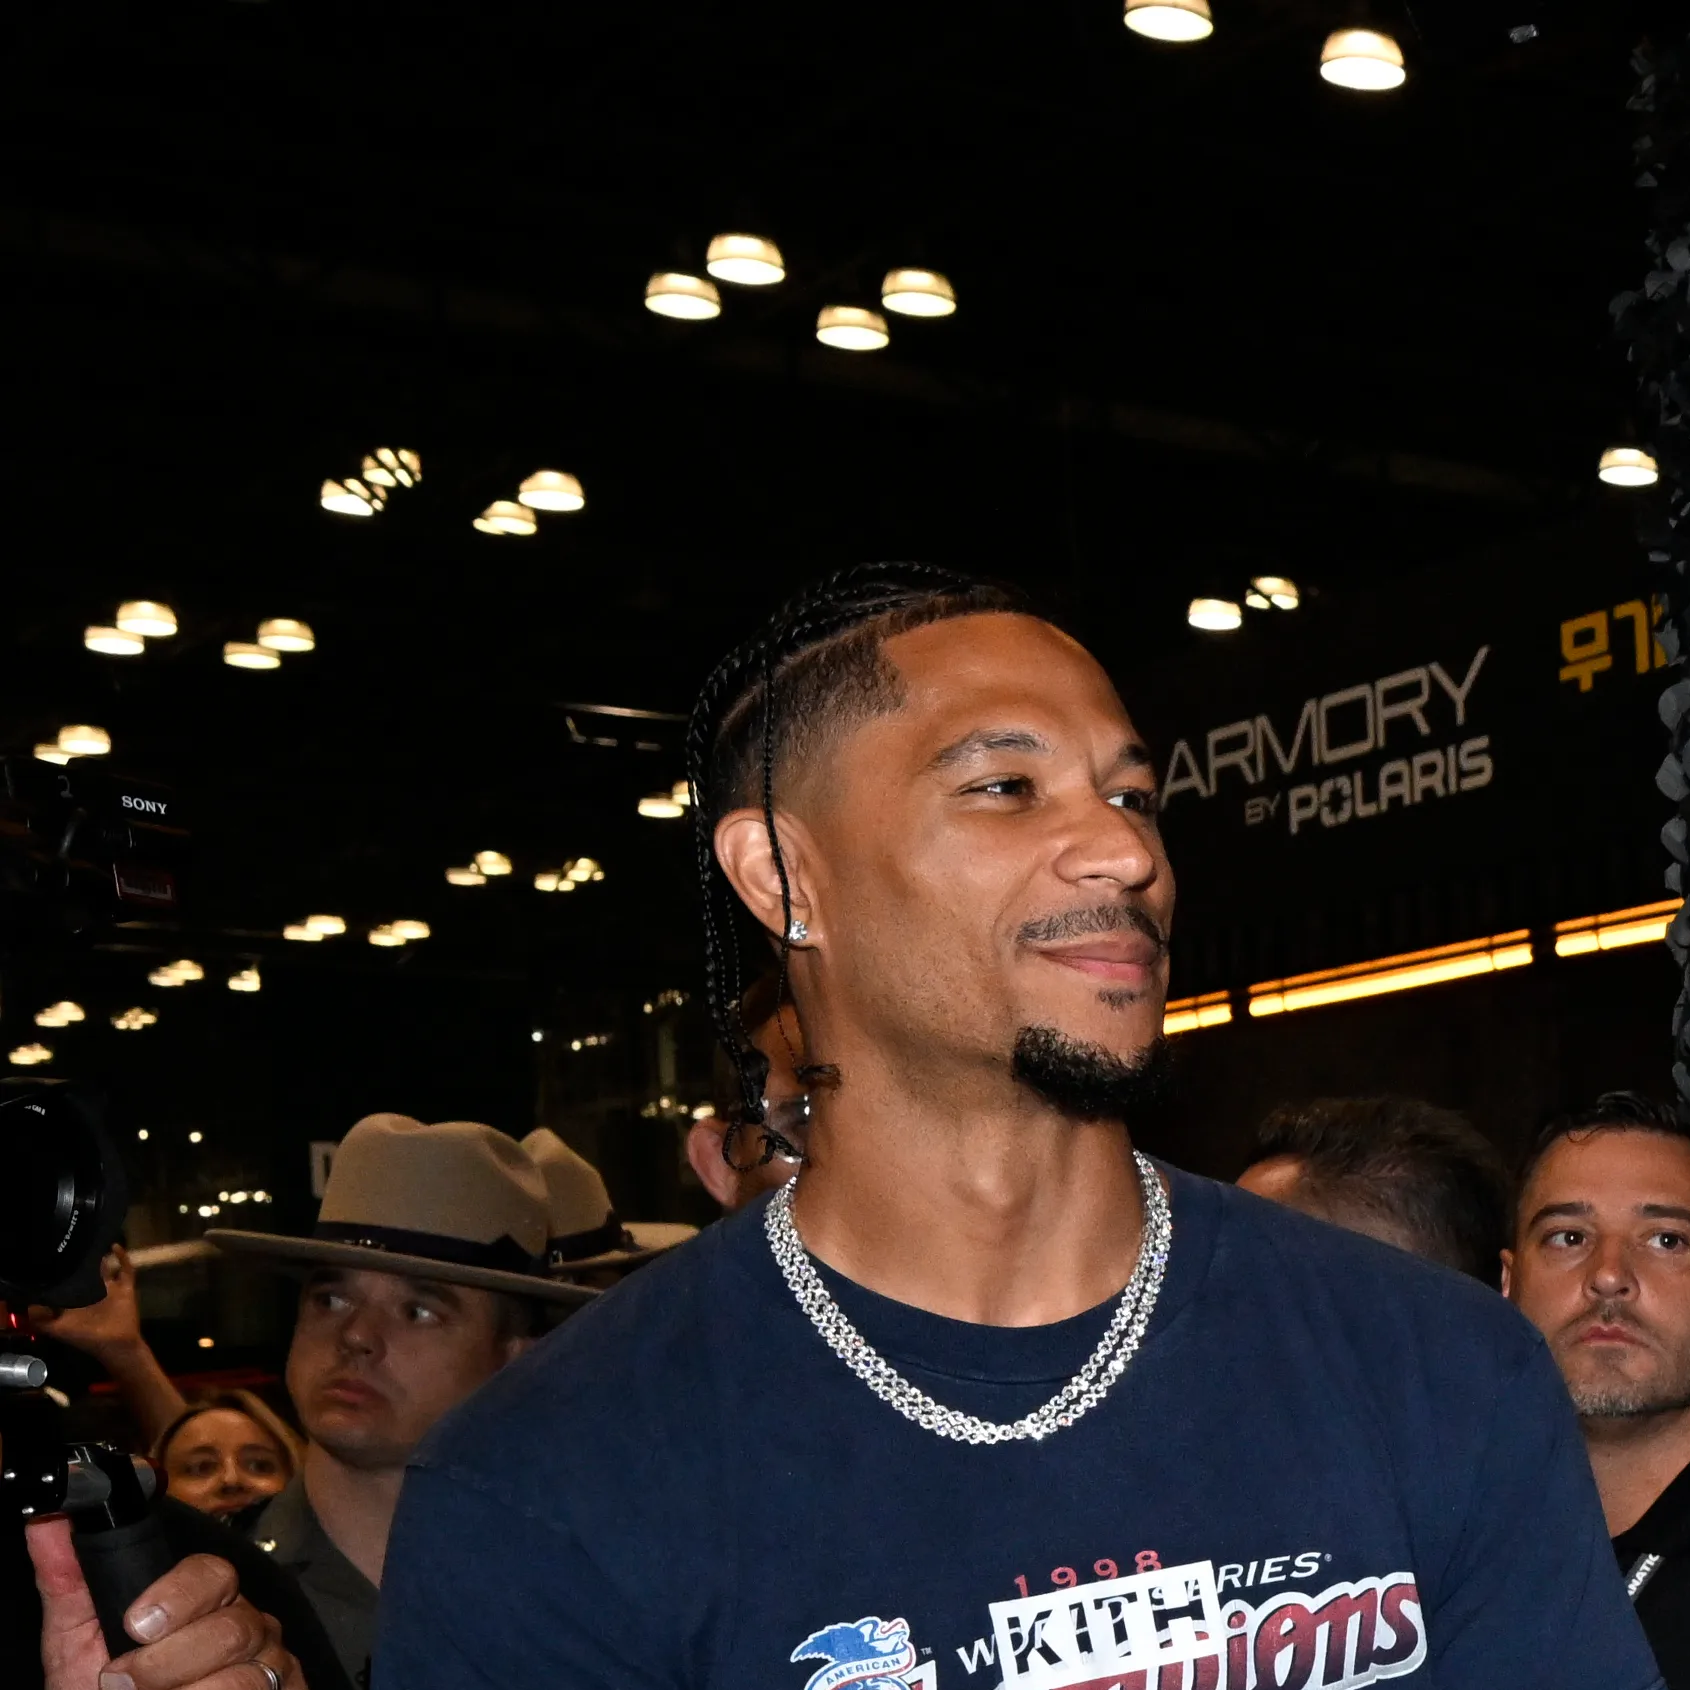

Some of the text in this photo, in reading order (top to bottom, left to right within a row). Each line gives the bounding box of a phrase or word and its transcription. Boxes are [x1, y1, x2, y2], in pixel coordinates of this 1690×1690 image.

[1158, 645, 1490, 811] ARMORY
[121, 795, 167, 815] SONY
[1245, 735, 1492, 835] BY POLARIS
[1014, 1550, 1162, 1598] 1998
[1627, 1553, 1660, 1597] ANATIC
[1007, 1562, 1214, 1677] KITH
[826, 1657, 901, 1686] AMERICAN
